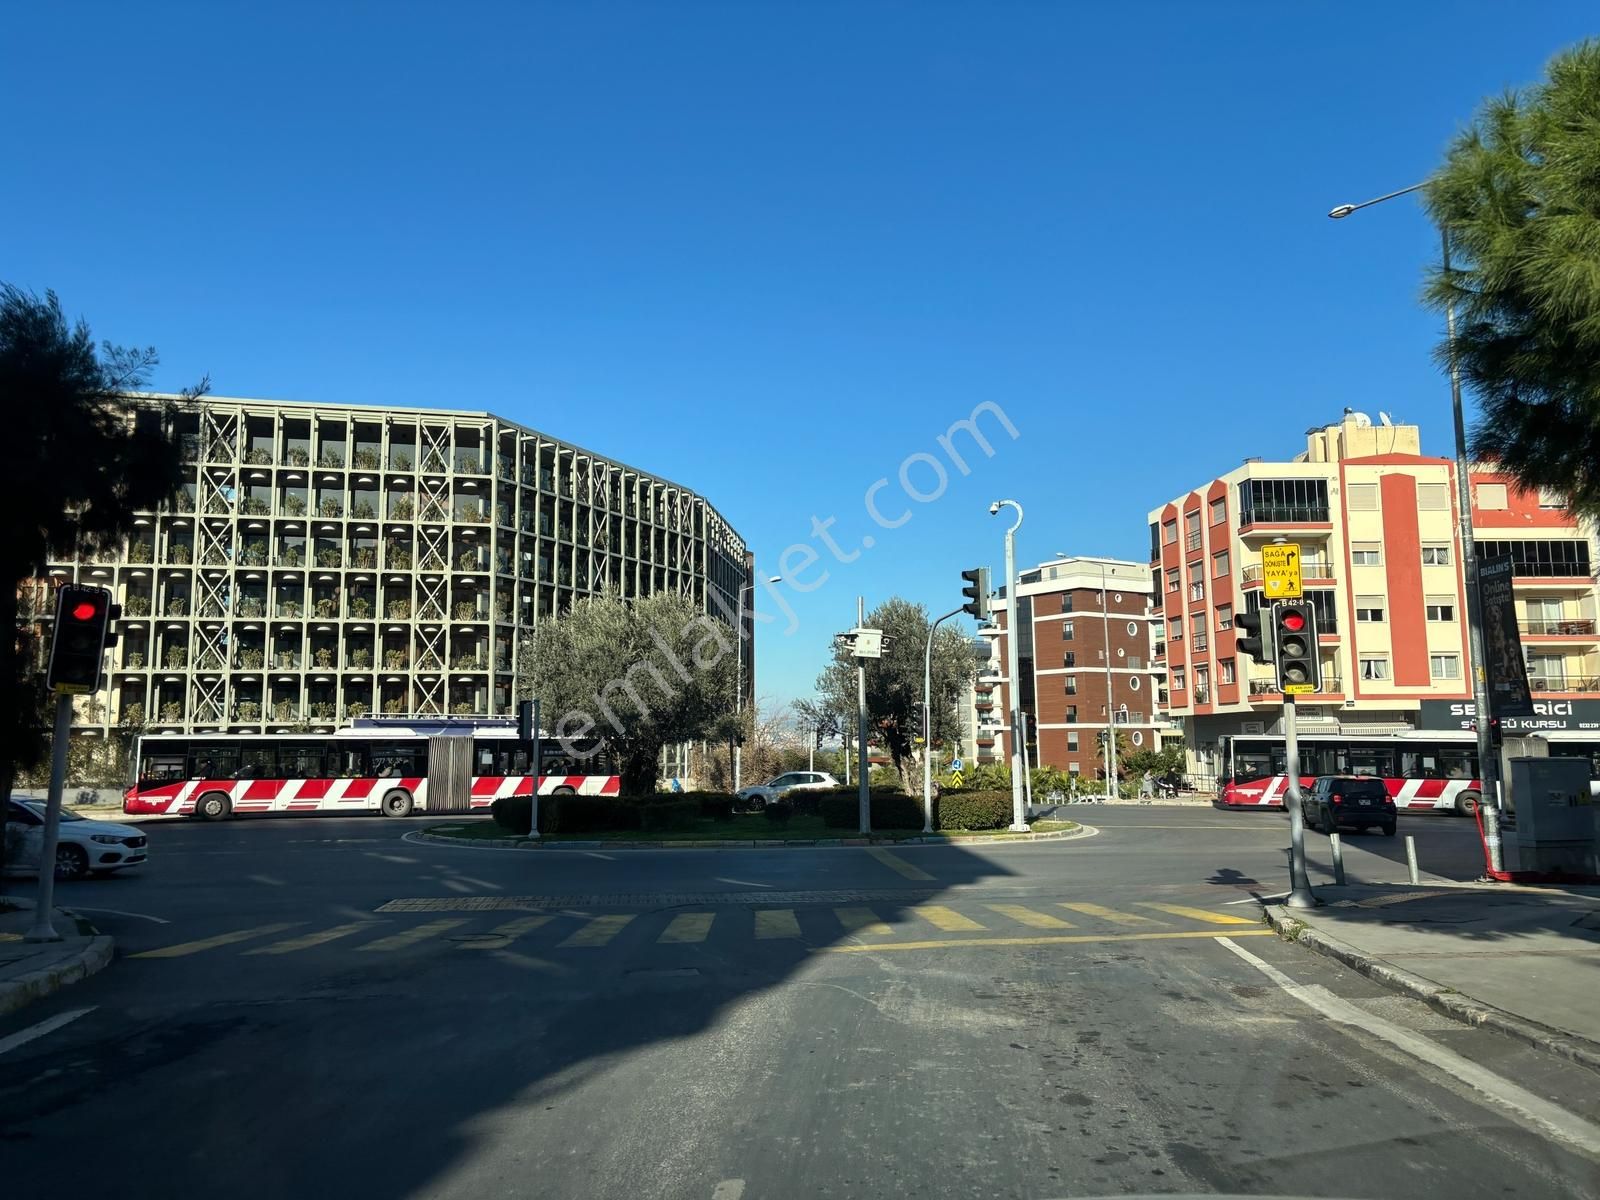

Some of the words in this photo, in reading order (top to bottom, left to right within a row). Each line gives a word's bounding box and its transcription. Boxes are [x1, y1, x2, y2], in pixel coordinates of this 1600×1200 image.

[1264, 550, 1286, 558] SAĞA
[1264, 560, 1287, 568] DÖNÜŞTE
[1483, 579, 1510, 596] Online
[1521, 720, 1567, 729] KURSU
